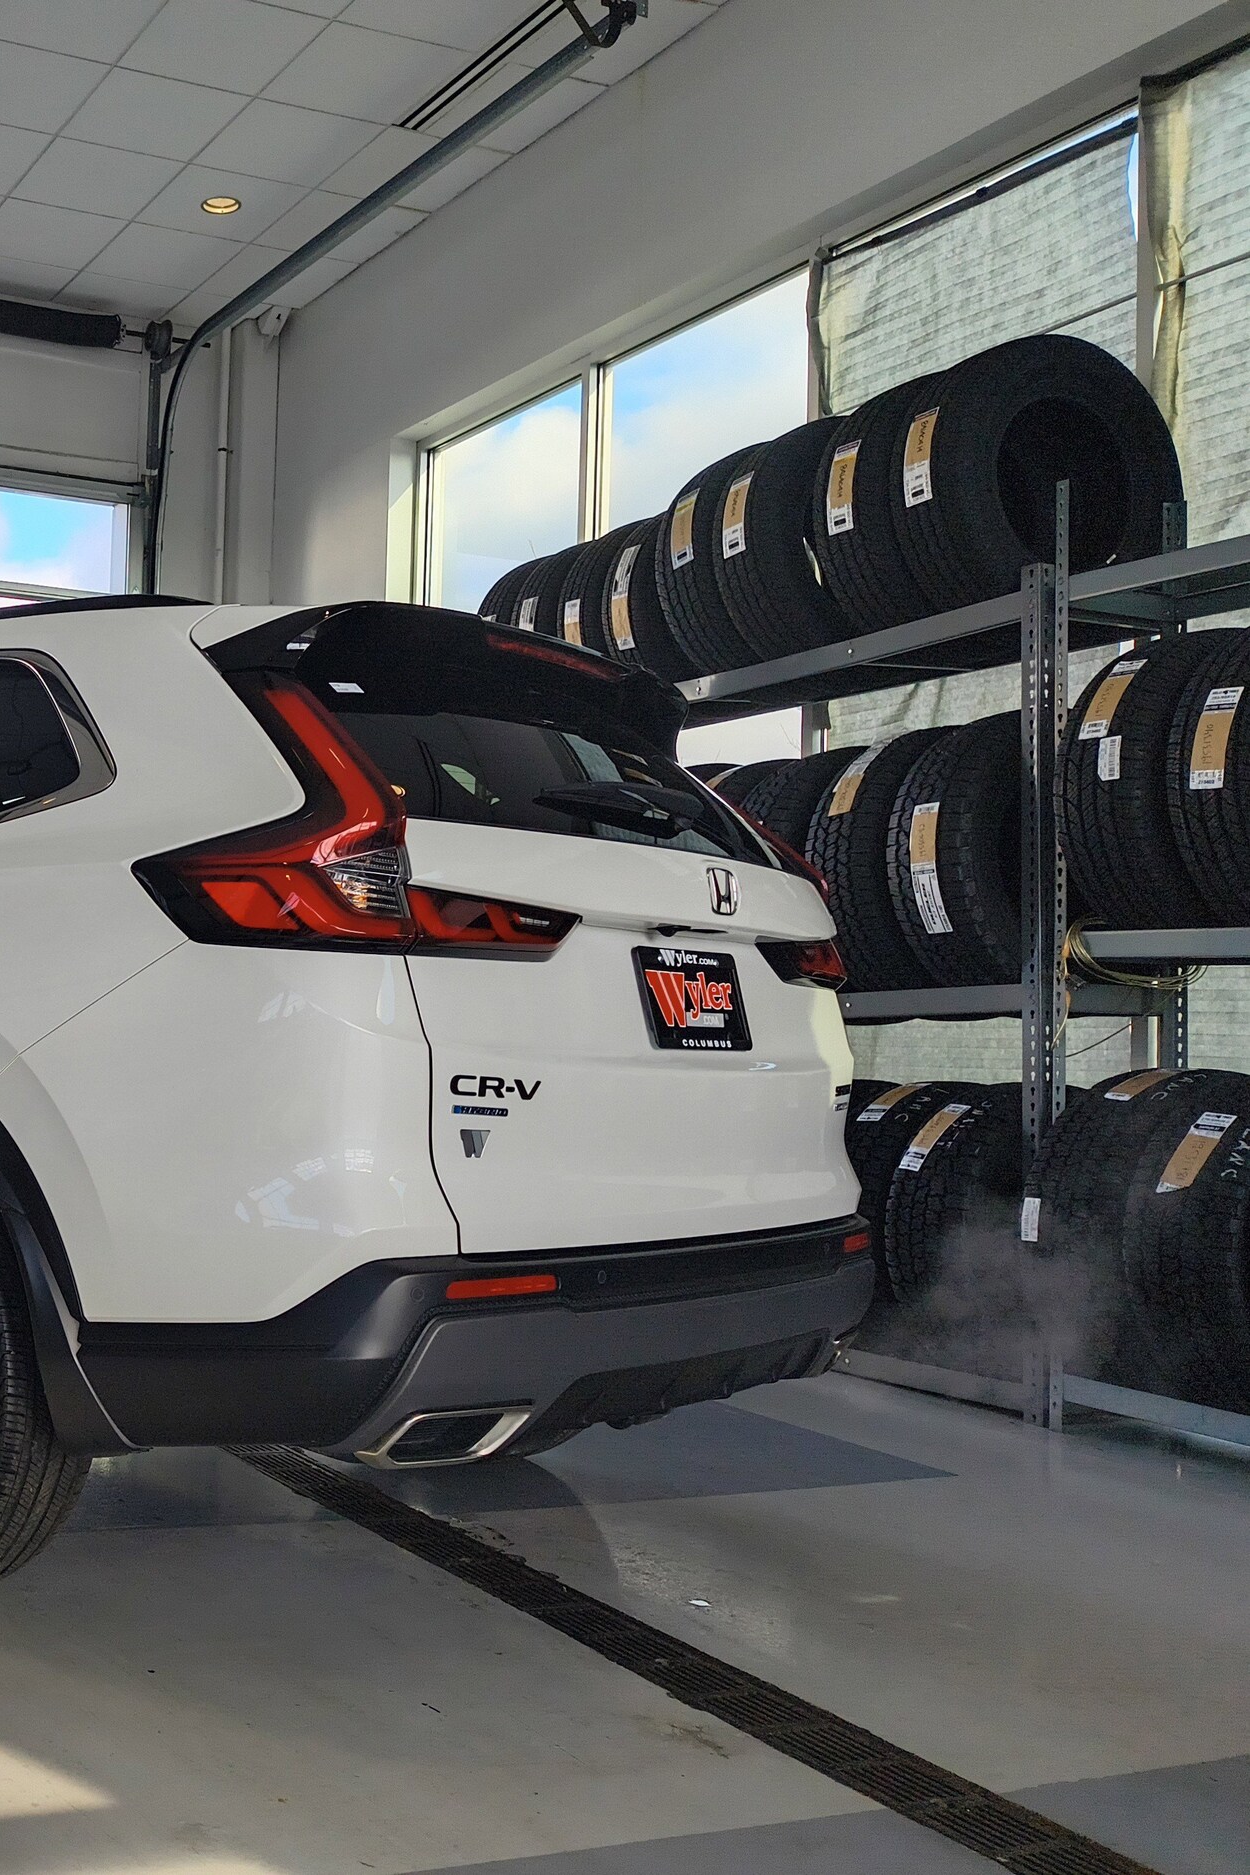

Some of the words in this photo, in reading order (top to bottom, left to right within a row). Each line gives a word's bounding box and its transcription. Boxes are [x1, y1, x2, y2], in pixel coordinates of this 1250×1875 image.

[645, 969, 733, 1028] Wyler
[682, 1039, 732, 1048] COLUMBUS
[449, 1074, 542, 1101] CR-V
